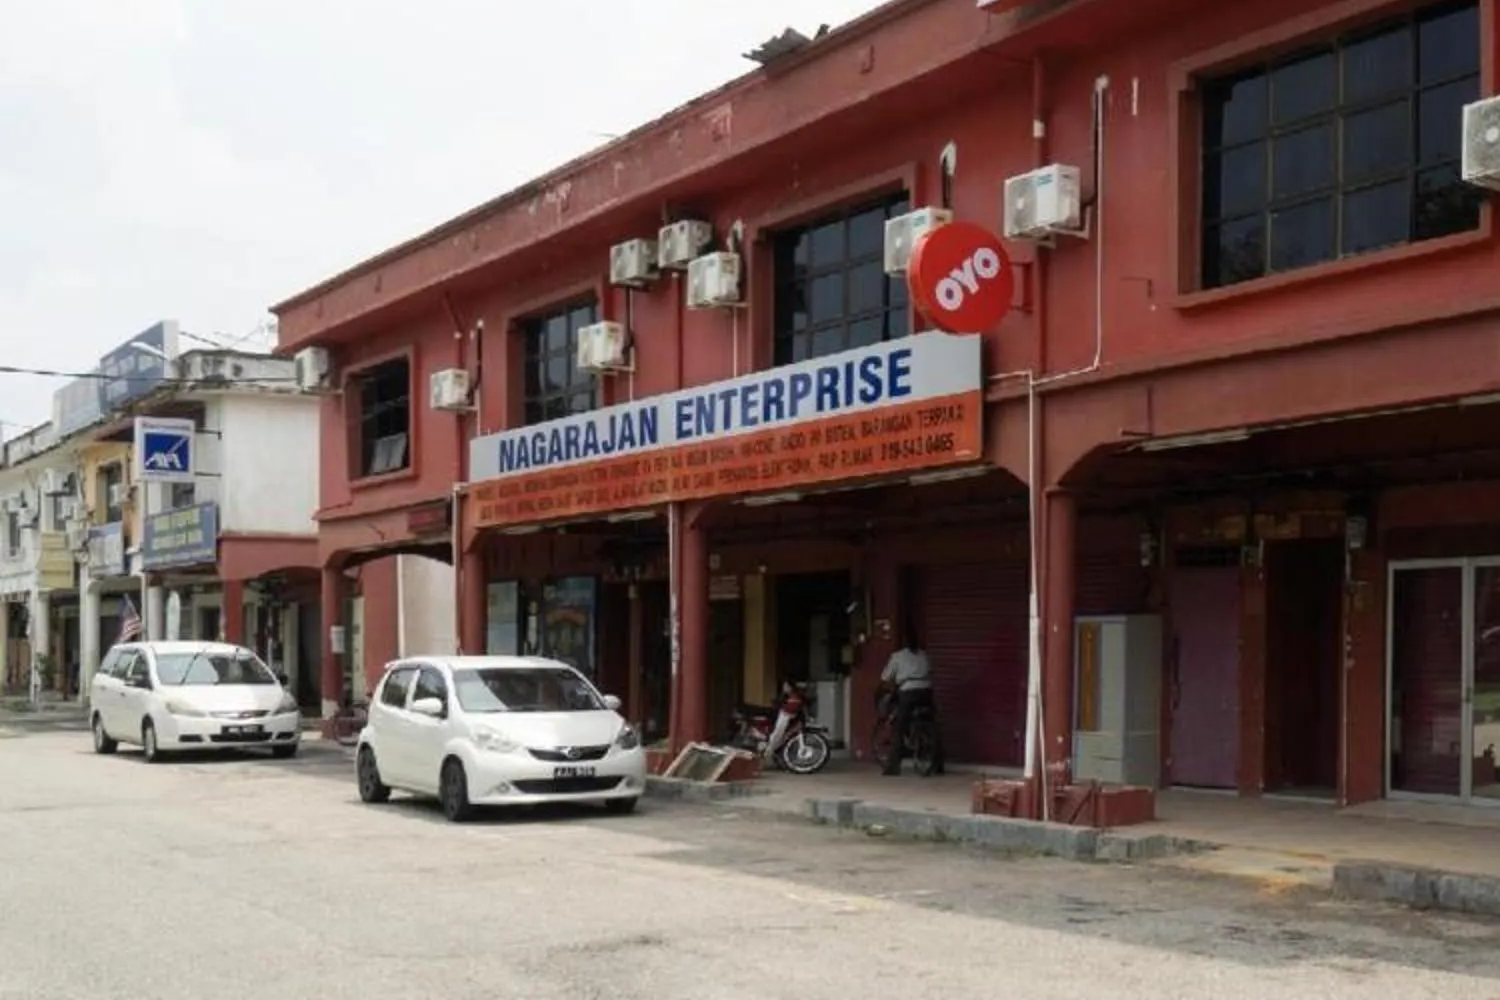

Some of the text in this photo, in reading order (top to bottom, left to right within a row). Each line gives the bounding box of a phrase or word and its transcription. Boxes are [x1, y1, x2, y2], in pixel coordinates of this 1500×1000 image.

[935, 247, 1000, 312] OYO
[499, 406, 659, 473] NAGARAJAN
[675, 349, 913, 440] ENTERPRISE
